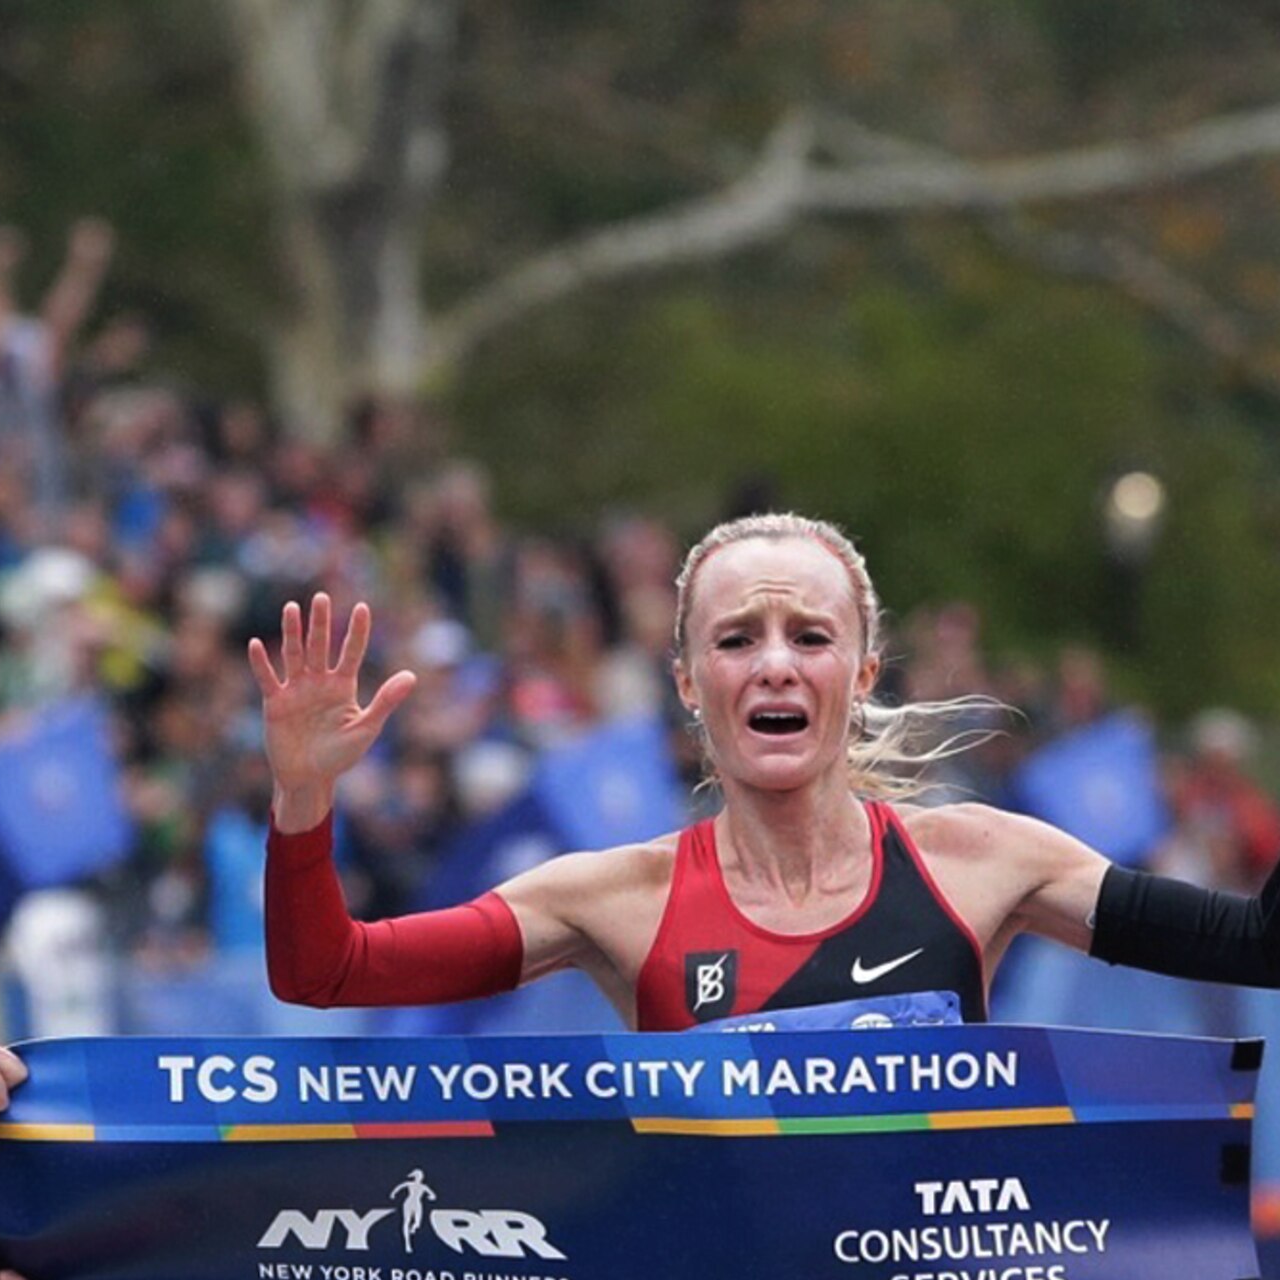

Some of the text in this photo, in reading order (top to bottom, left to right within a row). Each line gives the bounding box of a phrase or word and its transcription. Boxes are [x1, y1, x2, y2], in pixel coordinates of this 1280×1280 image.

[158, 1051, 1018, 1103] TCS NEW YORK CITY MARATHON
[915, 1177, 1031, 1215] TATA
[834, 1219, 1110, 1264] CONSULTANCY
[258, 1262, 313, 1280] NEW
